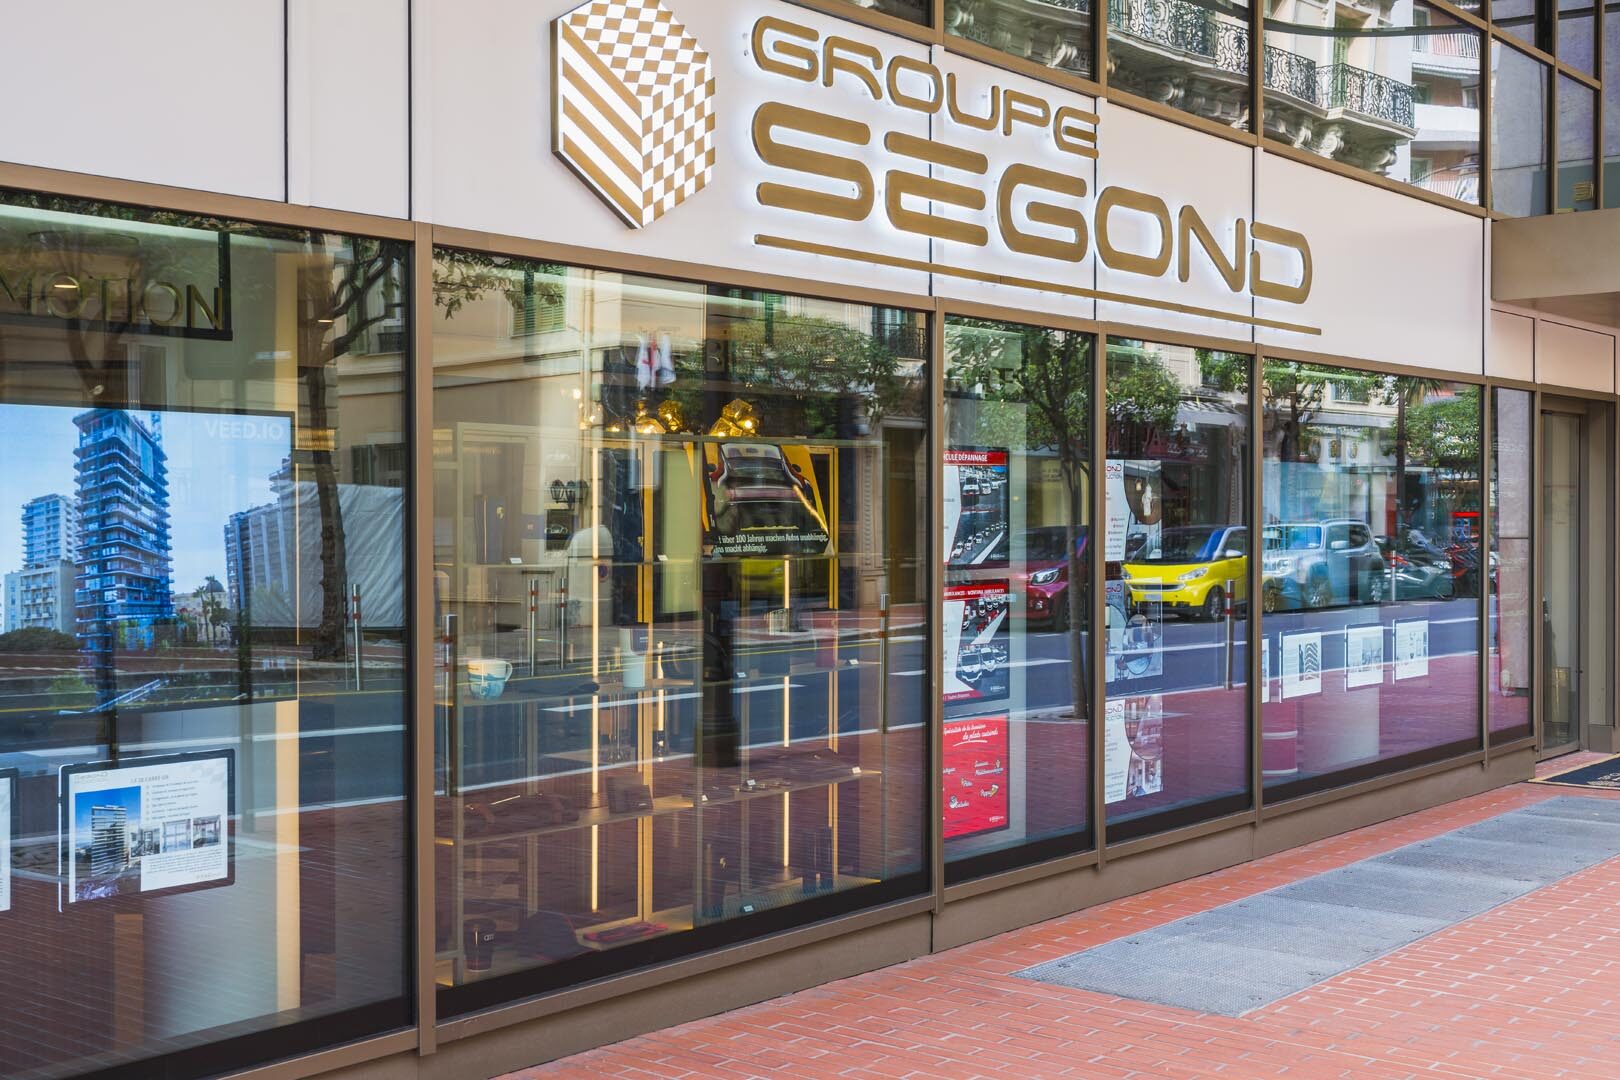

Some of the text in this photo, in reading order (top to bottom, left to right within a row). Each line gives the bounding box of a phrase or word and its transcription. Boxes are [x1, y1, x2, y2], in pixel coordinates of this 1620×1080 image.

[752, 15, 1101, 159] GROUPE
[752, 101, 1313, 304] SEGOND
[206, 420, 284, 440] VEED.IO
[735, 534, 746, 543] 100
[747, 534, 765, 543] Jahren
